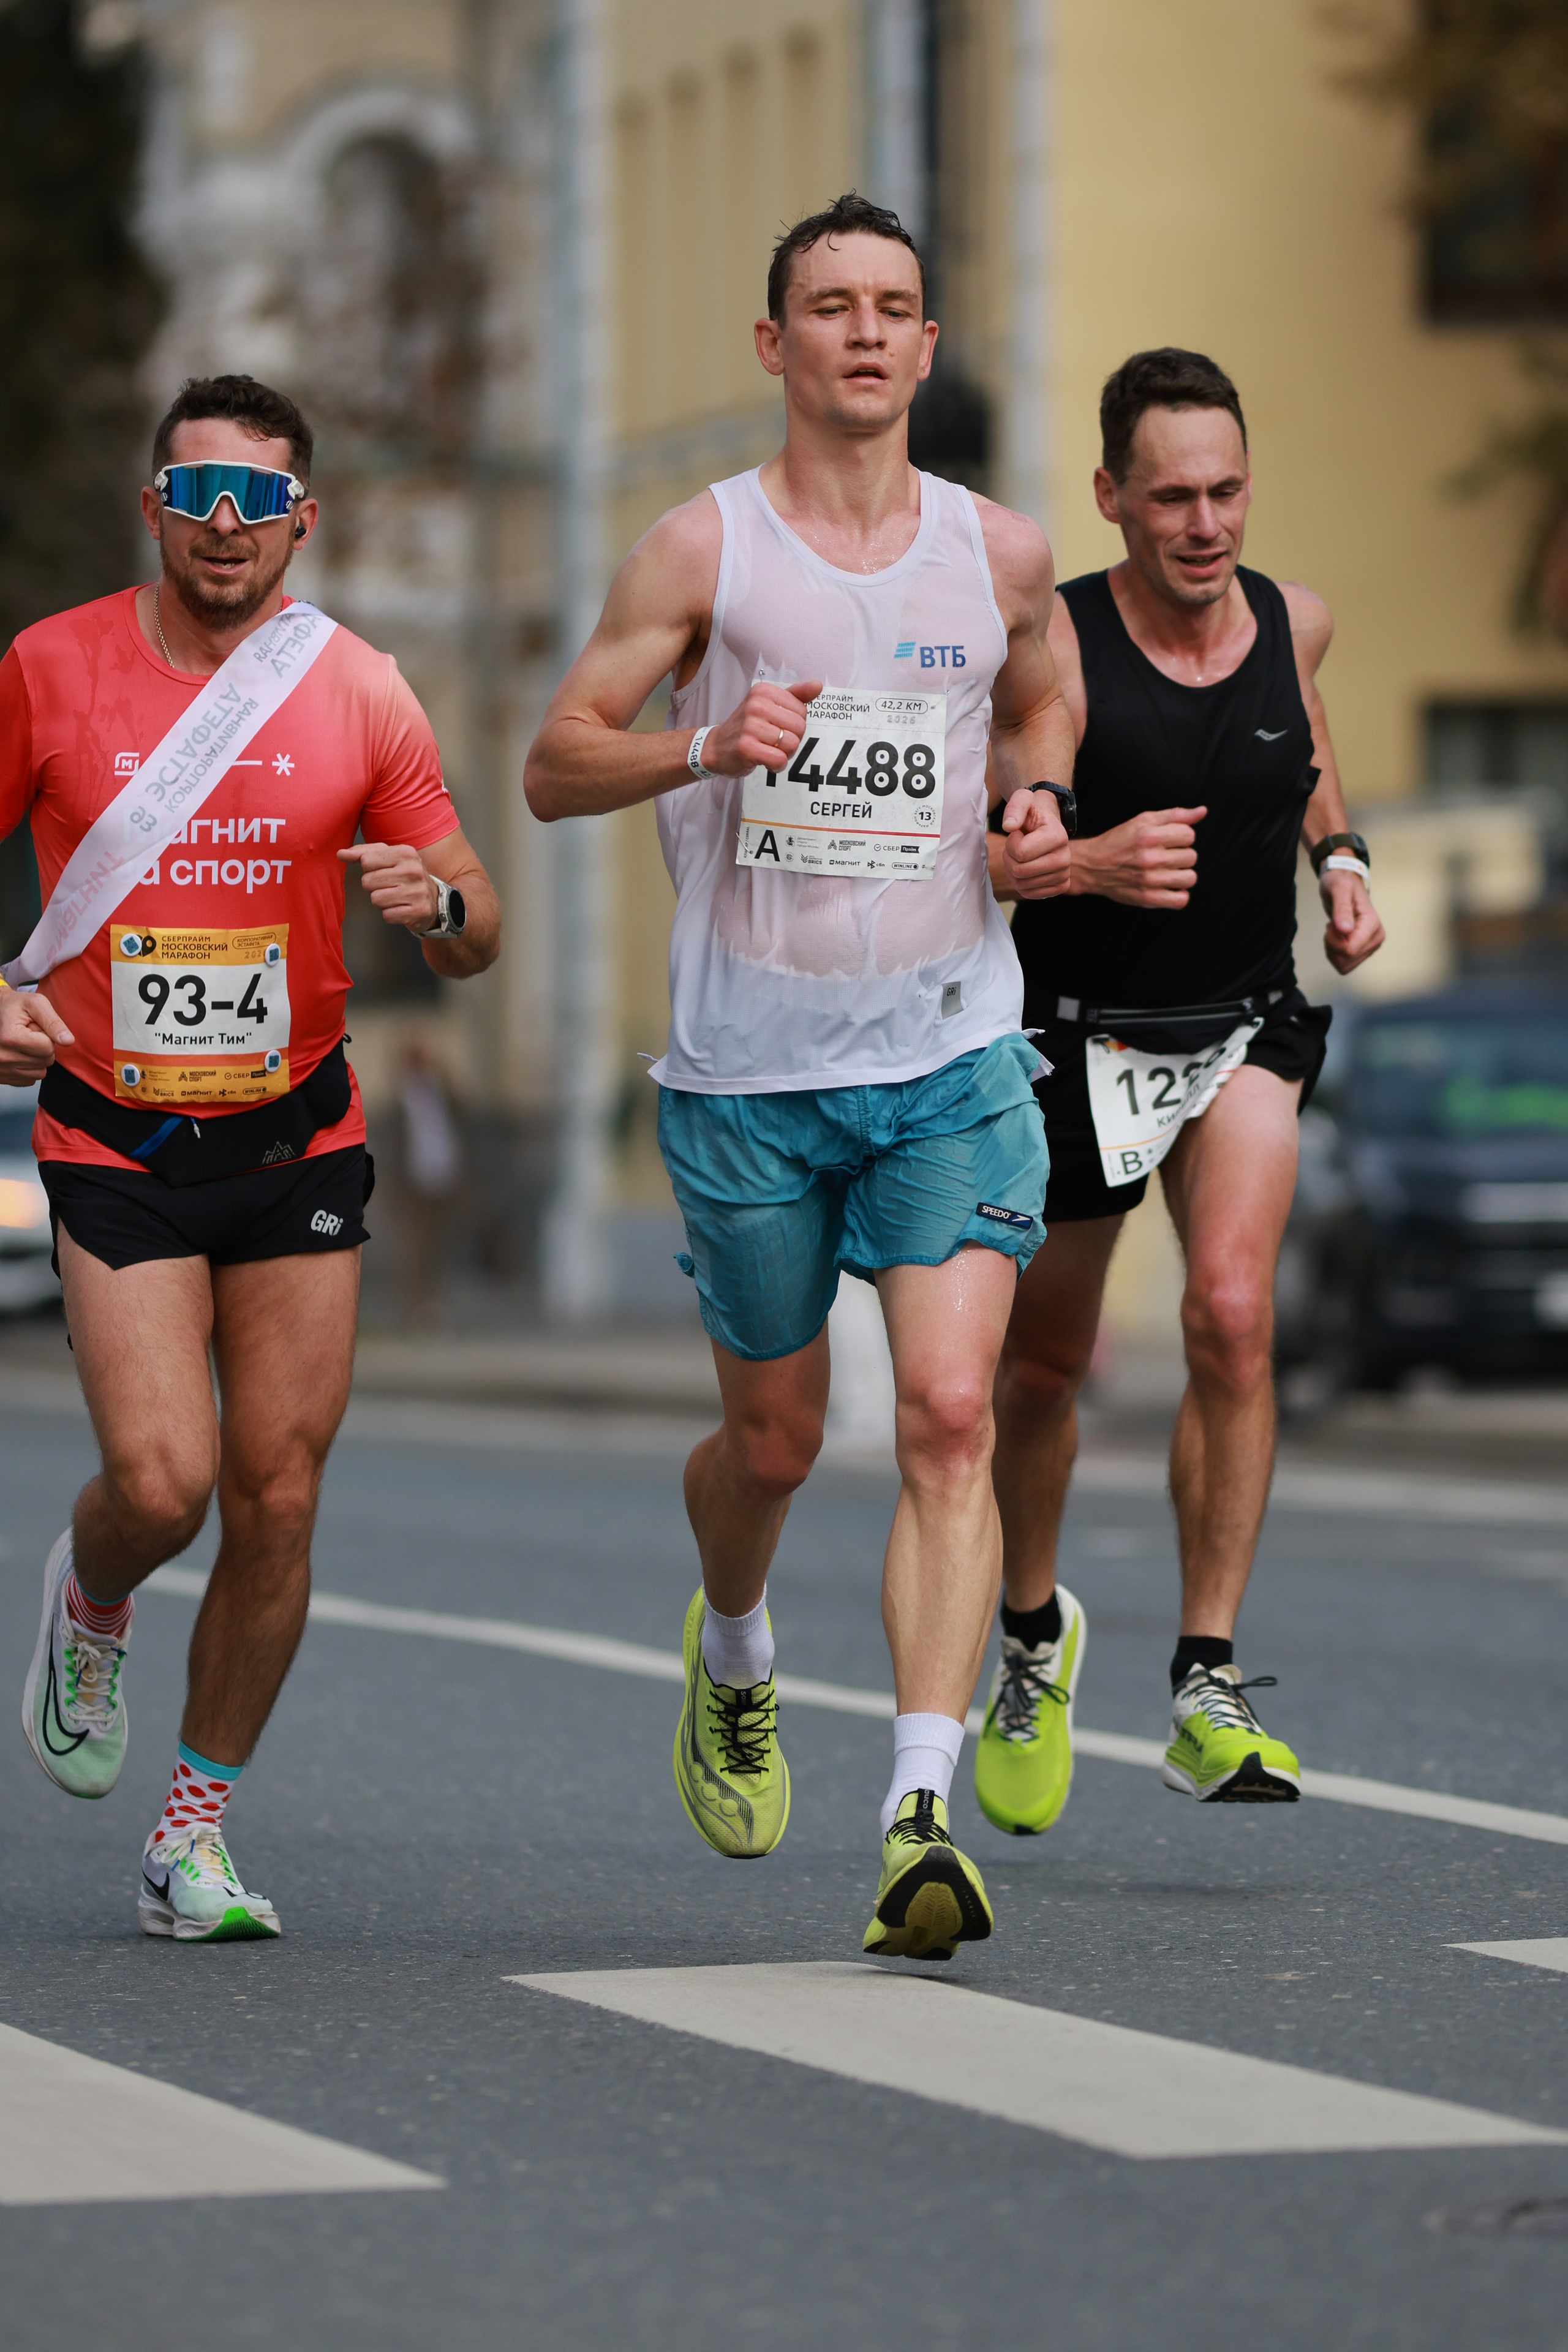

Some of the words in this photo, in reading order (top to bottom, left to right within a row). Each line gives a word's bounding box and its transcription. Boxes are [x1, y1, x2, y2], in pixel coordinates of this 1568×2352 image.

[919, 645, 966, 668] ВТБ
[816, 693, 853, 703] ЕРПРАЙМ
[805, 701, 870, 713] МОСКОВСКИЙ
[881, 700, 903, 710] 42,2
[905, 702, 922, 711] КМ
[886, 715, 916, 725] 2026
[690, 736, 703, 768] 14488
[810, 801, 873, 818] СЕРГЕЙ
[919, 812, 932, 821] 13
[170, 859, 292, 894] спорт
[236, 934, 274, 943] КОРПОРАТИВНАЯ
[161, 942, 228, 951] МОСКОВСКИЙ
[244, 949, 263, 959] 202
[138, 973, 268, 1027] 93-4
[154, 1033, 214, 1045] "Магнит
[218, 1032, 252, 1044] Тим"
